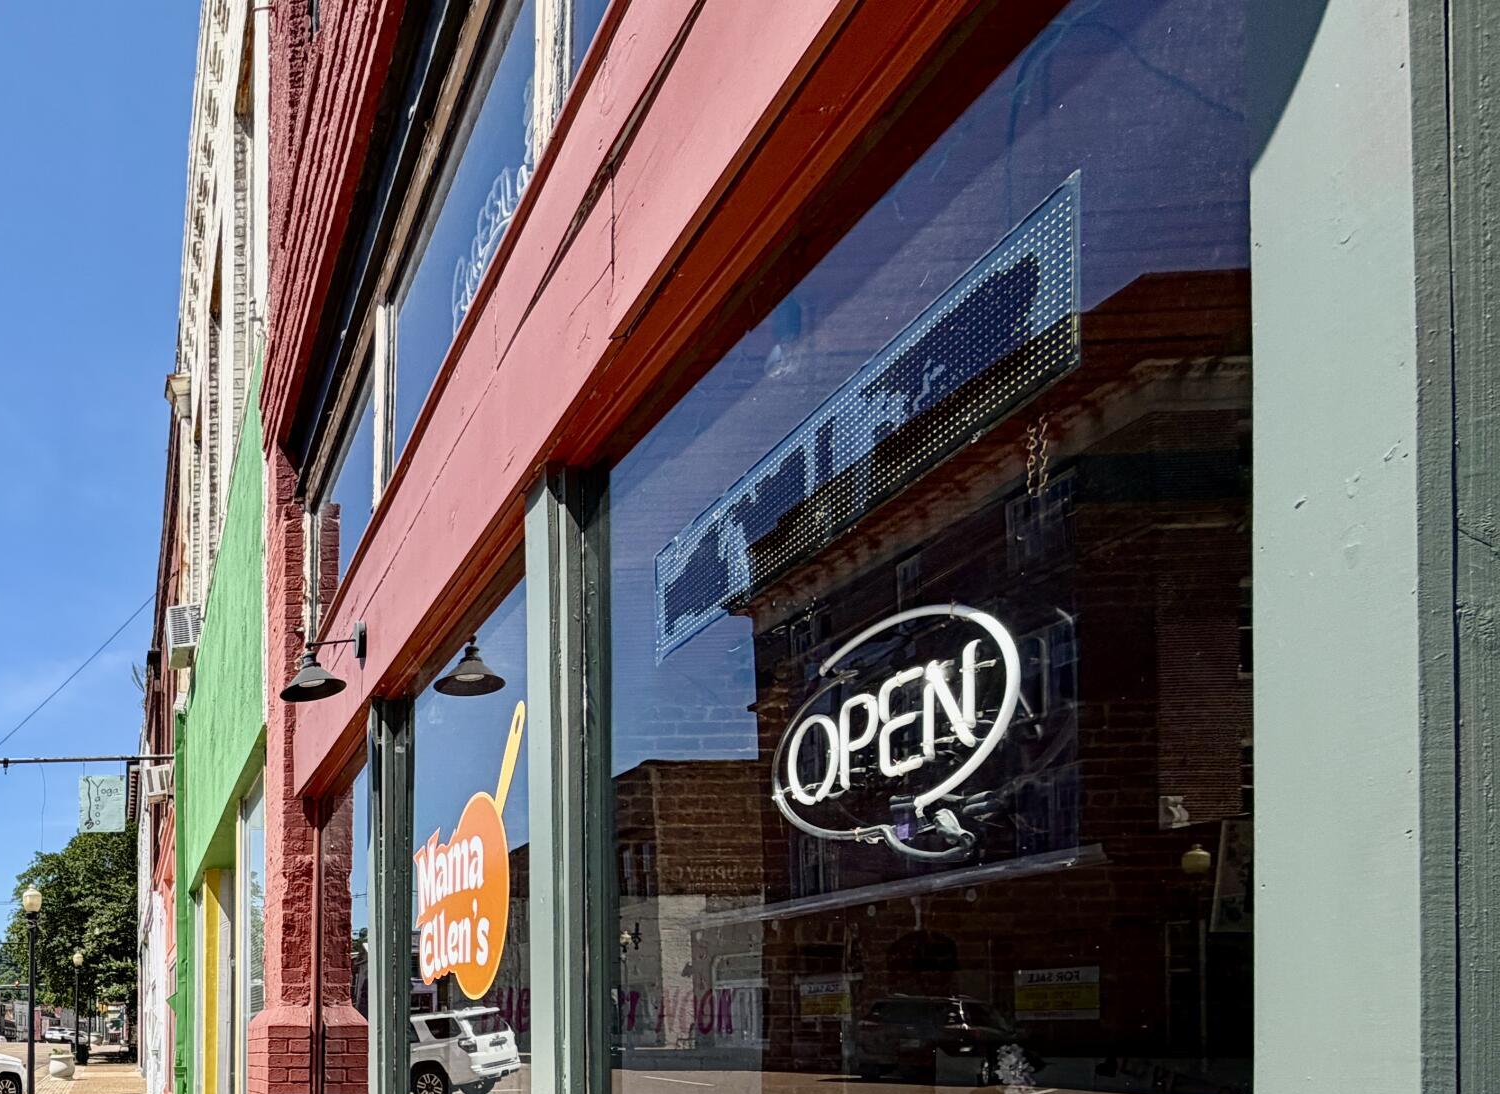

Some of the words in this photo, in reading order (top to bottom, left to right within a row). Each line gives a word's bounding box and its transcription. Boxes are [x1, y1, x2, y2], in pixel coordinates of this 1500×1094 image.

[787, 638, 982, 806] OPEN
[91, 779, 118, 797] Yoga
[417, 835, 485, 917] Mama
